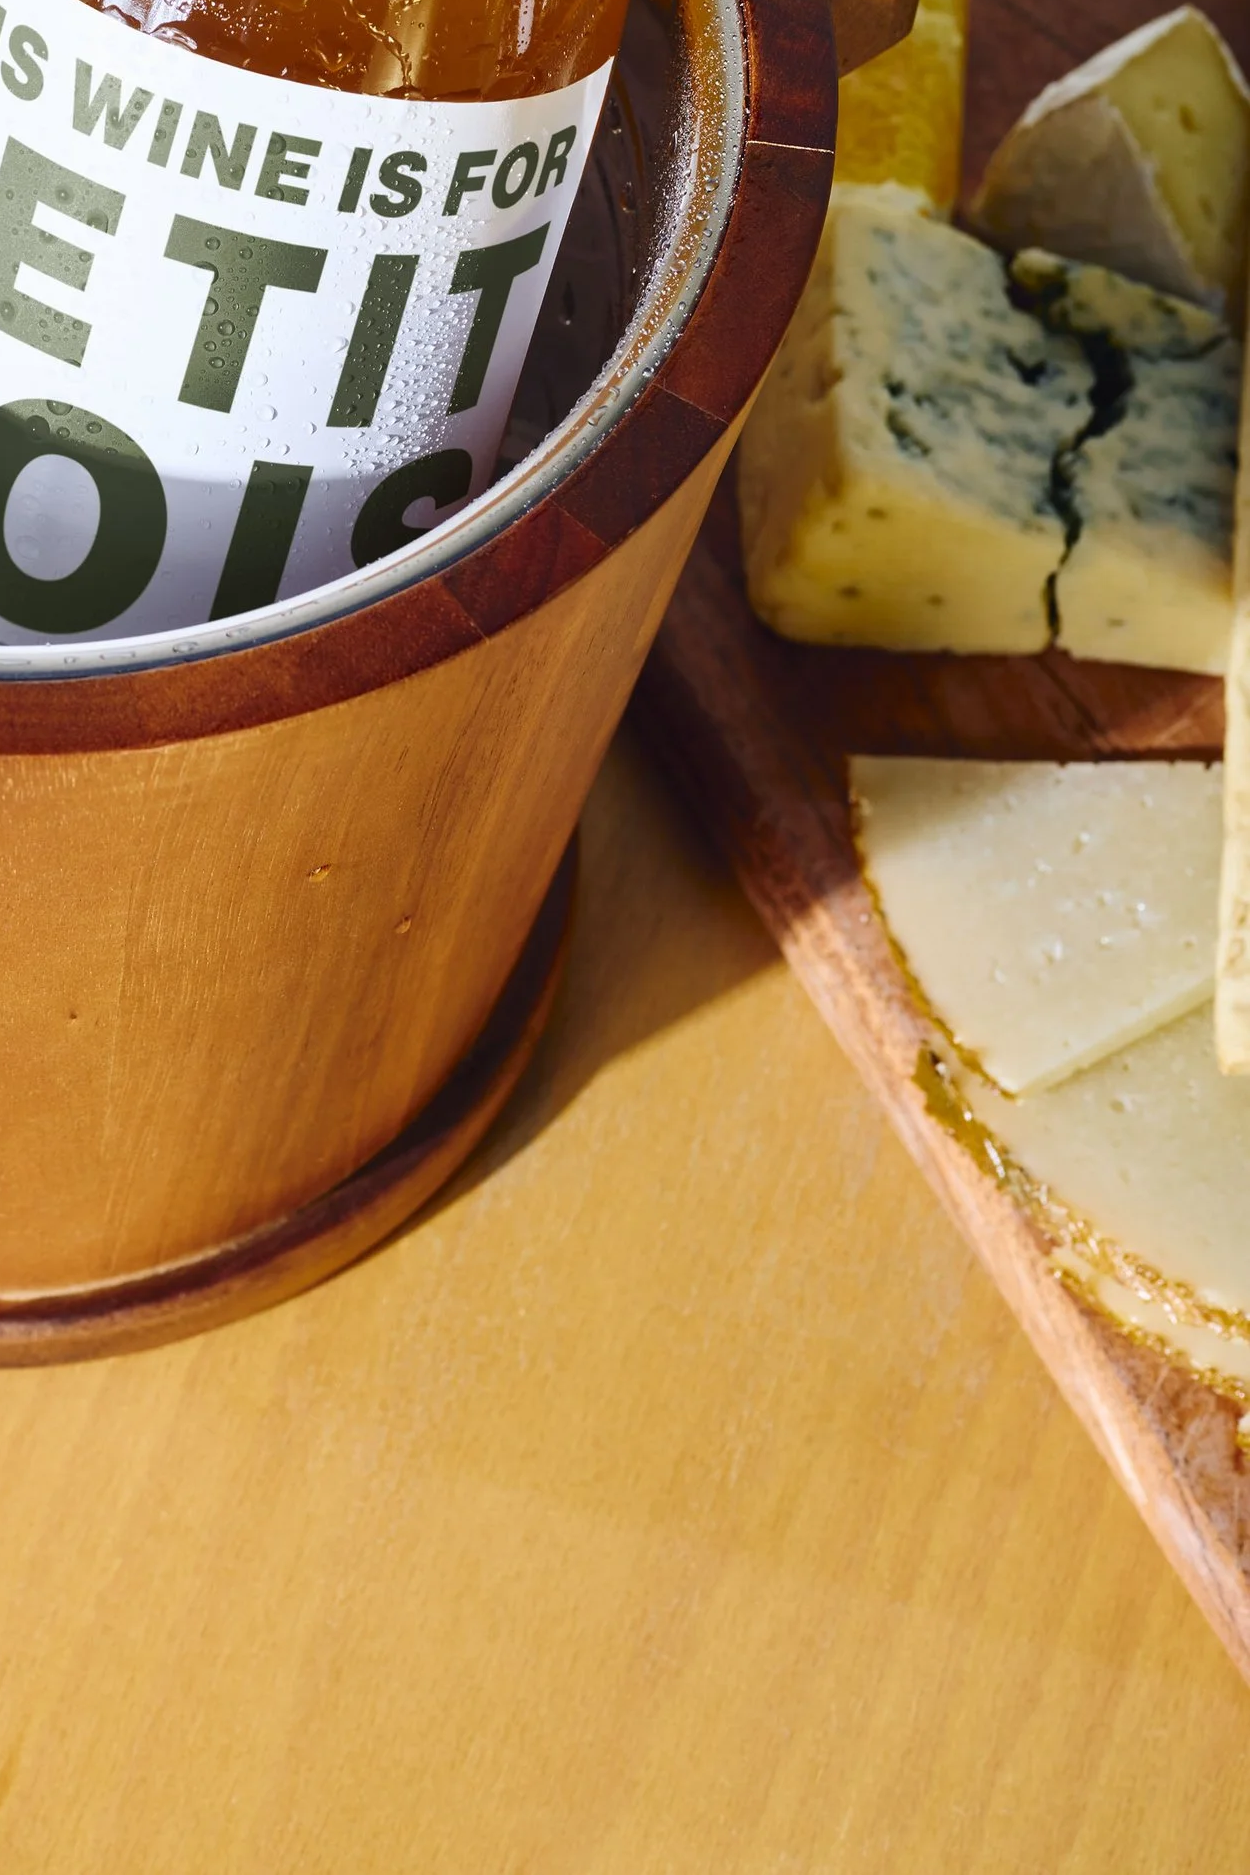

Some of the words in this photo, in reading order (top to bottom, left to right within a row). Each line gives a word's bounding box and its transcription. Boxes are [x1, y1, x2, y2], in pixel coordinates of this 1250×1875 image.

[71, 58, 323, 206] WINE
[337, 147, 427, 218] IS
[442, 124, 577, 215] FOR
